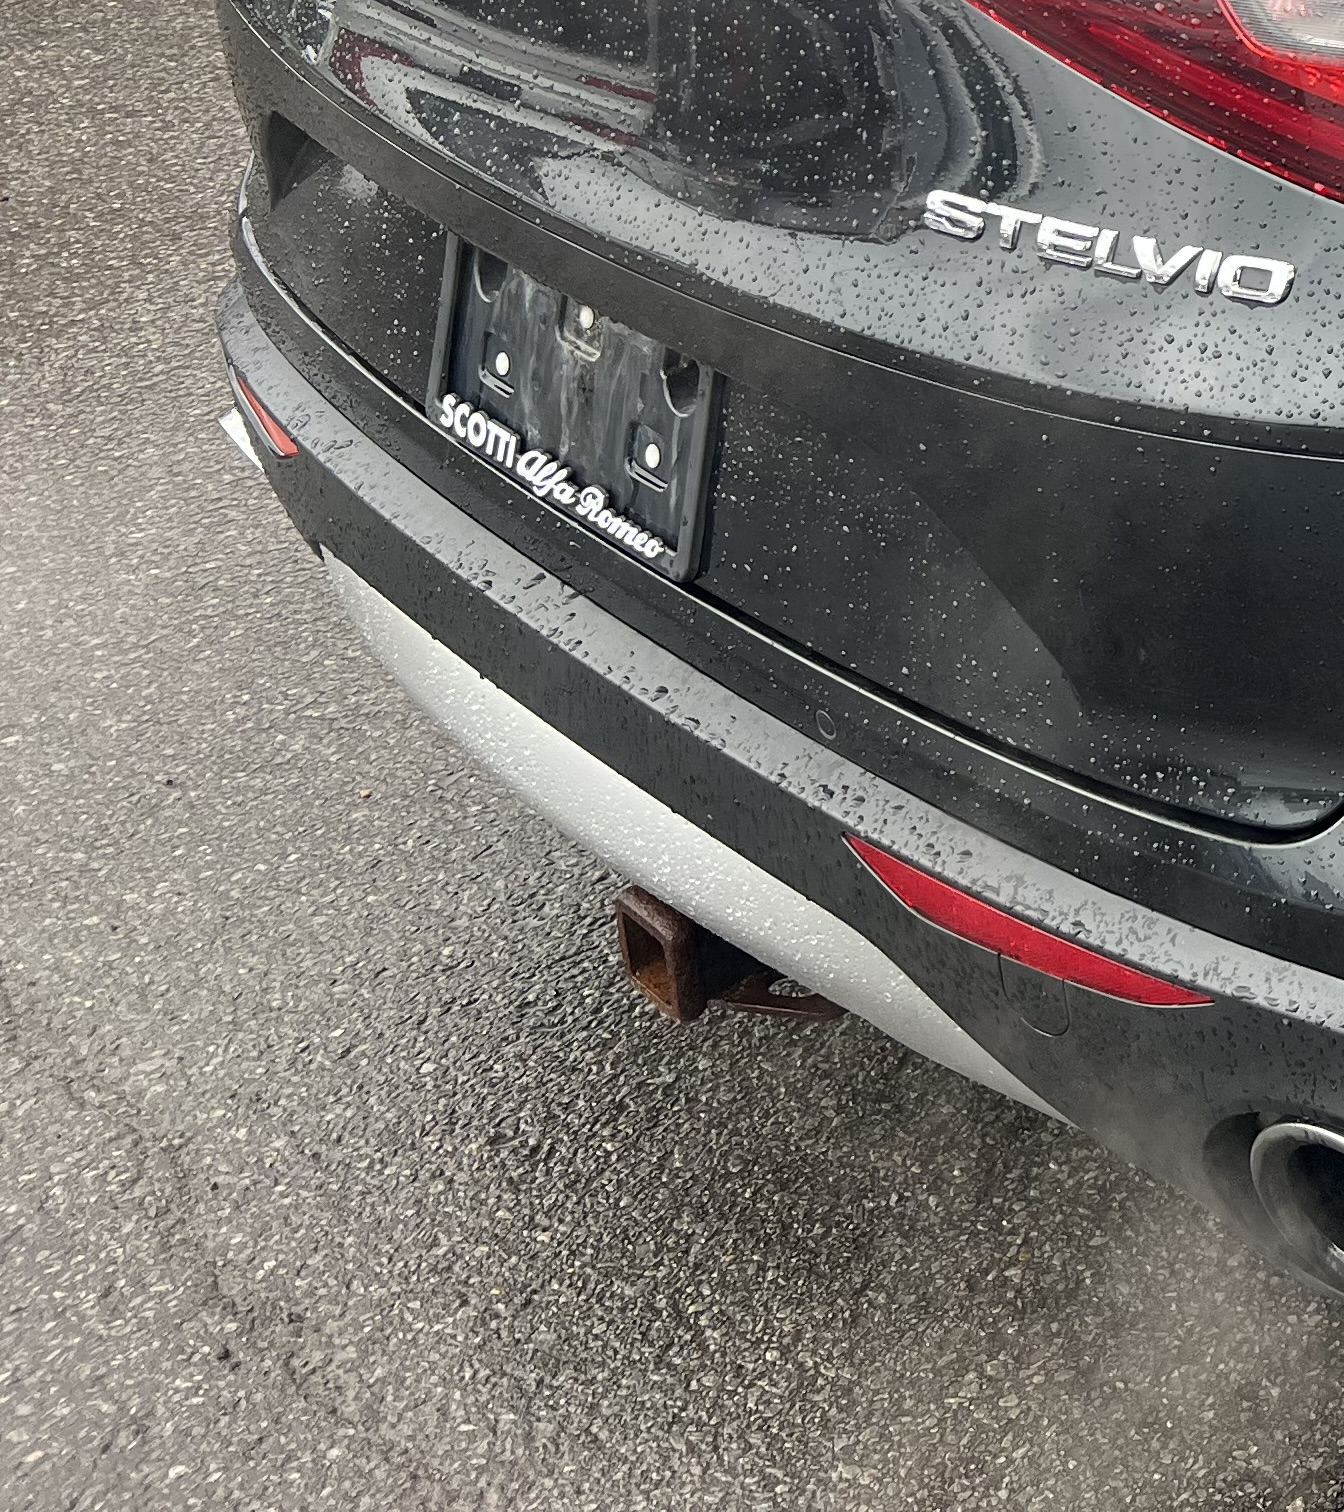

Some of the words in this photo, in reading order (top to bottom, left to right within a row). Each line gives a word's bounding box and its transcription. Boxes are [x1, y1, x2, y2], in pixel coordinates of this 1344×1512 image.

[922, 189, 1297, 304] STELVIO
[440, 393, 518, 469] SCOTTI
[516, 449, 576, 505] Alfa
[575, 485, 665, 559] Romeo
